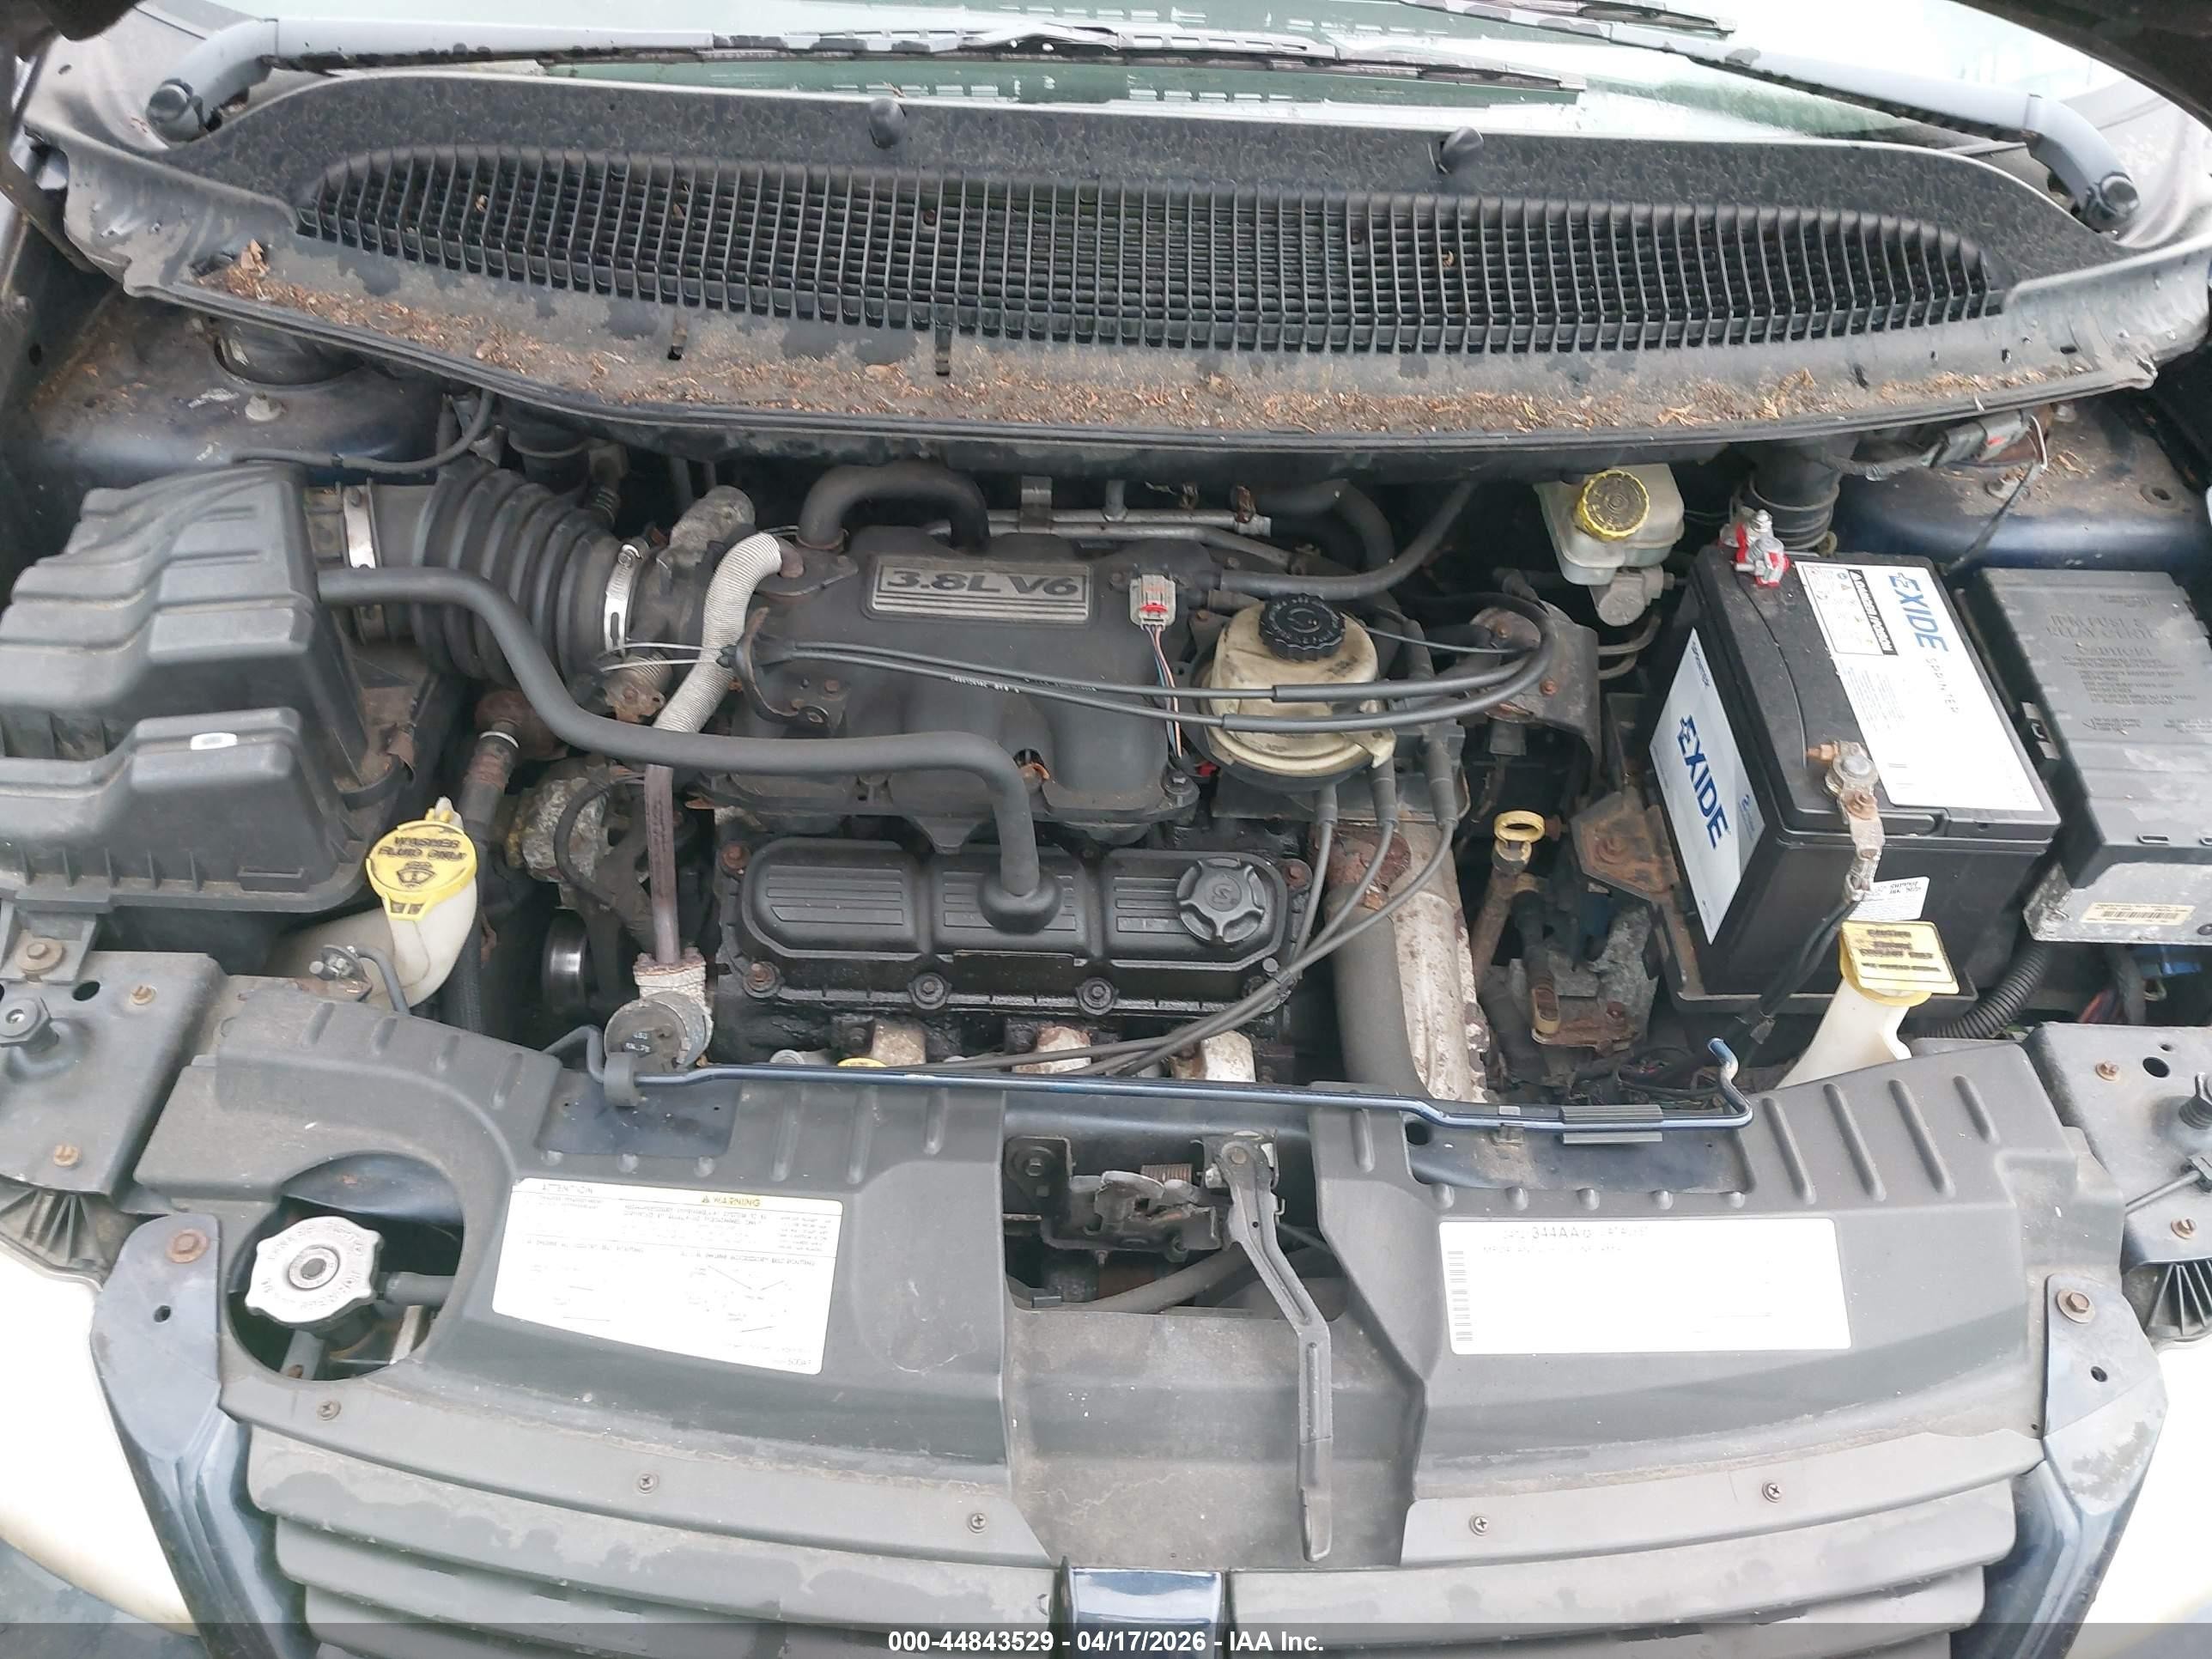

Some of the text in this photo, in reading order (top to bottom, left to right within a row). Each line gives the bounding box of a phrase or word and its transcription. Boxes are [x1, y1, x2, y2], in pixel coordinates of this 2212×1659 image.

[886, 570, 1079, 597] 3.8L V6
[1889, 572, 1949, 653] EXIDE
[1676, 714, 1729, 851] EXIDE
[714, 1196, 762, 1208] WARNING
